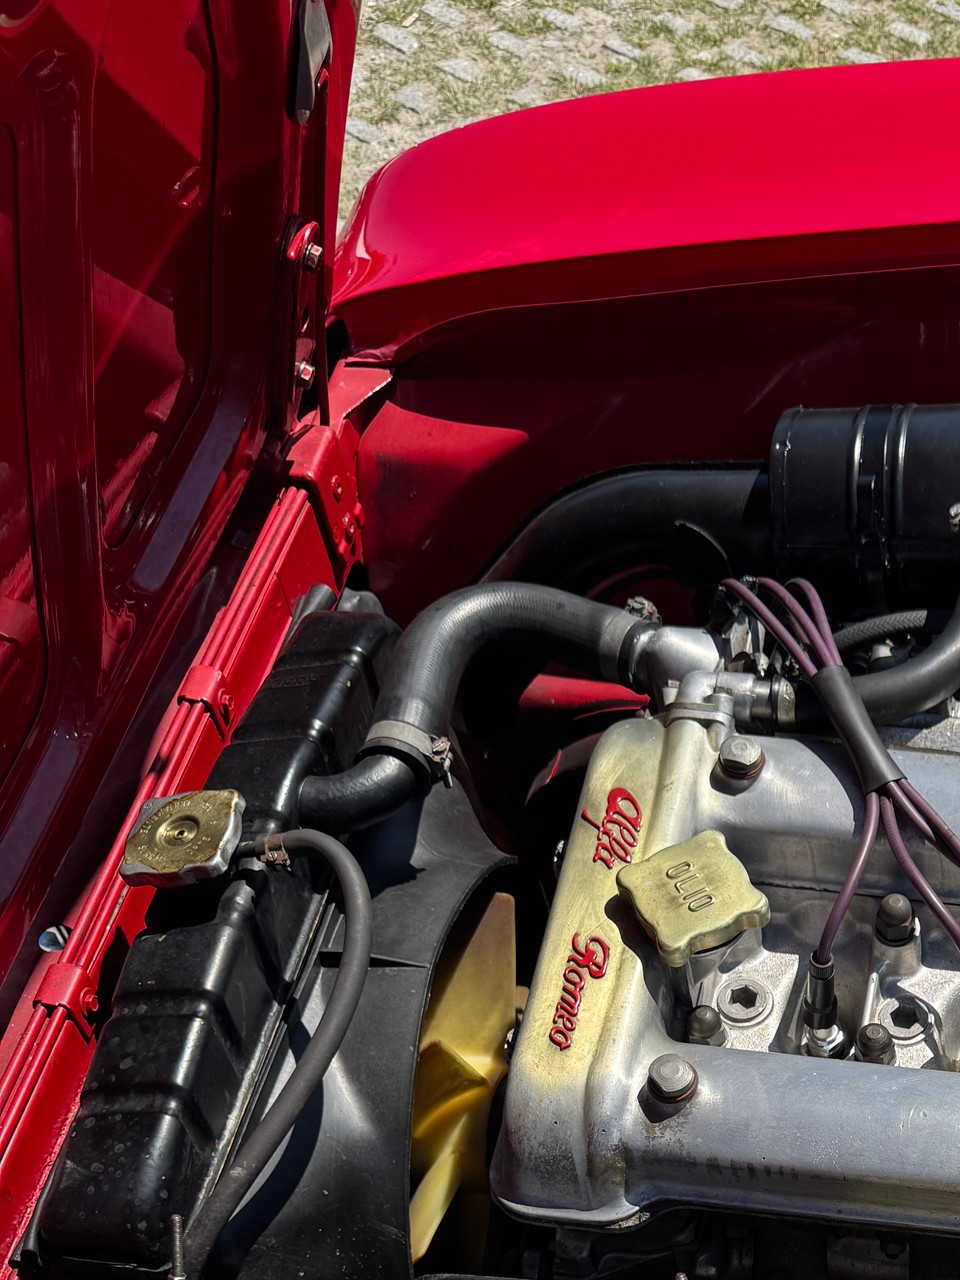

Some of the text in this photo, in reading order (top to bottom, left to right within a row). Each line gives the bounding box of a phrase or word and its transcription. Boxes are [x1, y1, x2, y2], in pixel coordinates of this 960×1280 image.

[550, 788, 641, 1050] Alfa Romeo
[666, 861, 715, 912] OLIO
